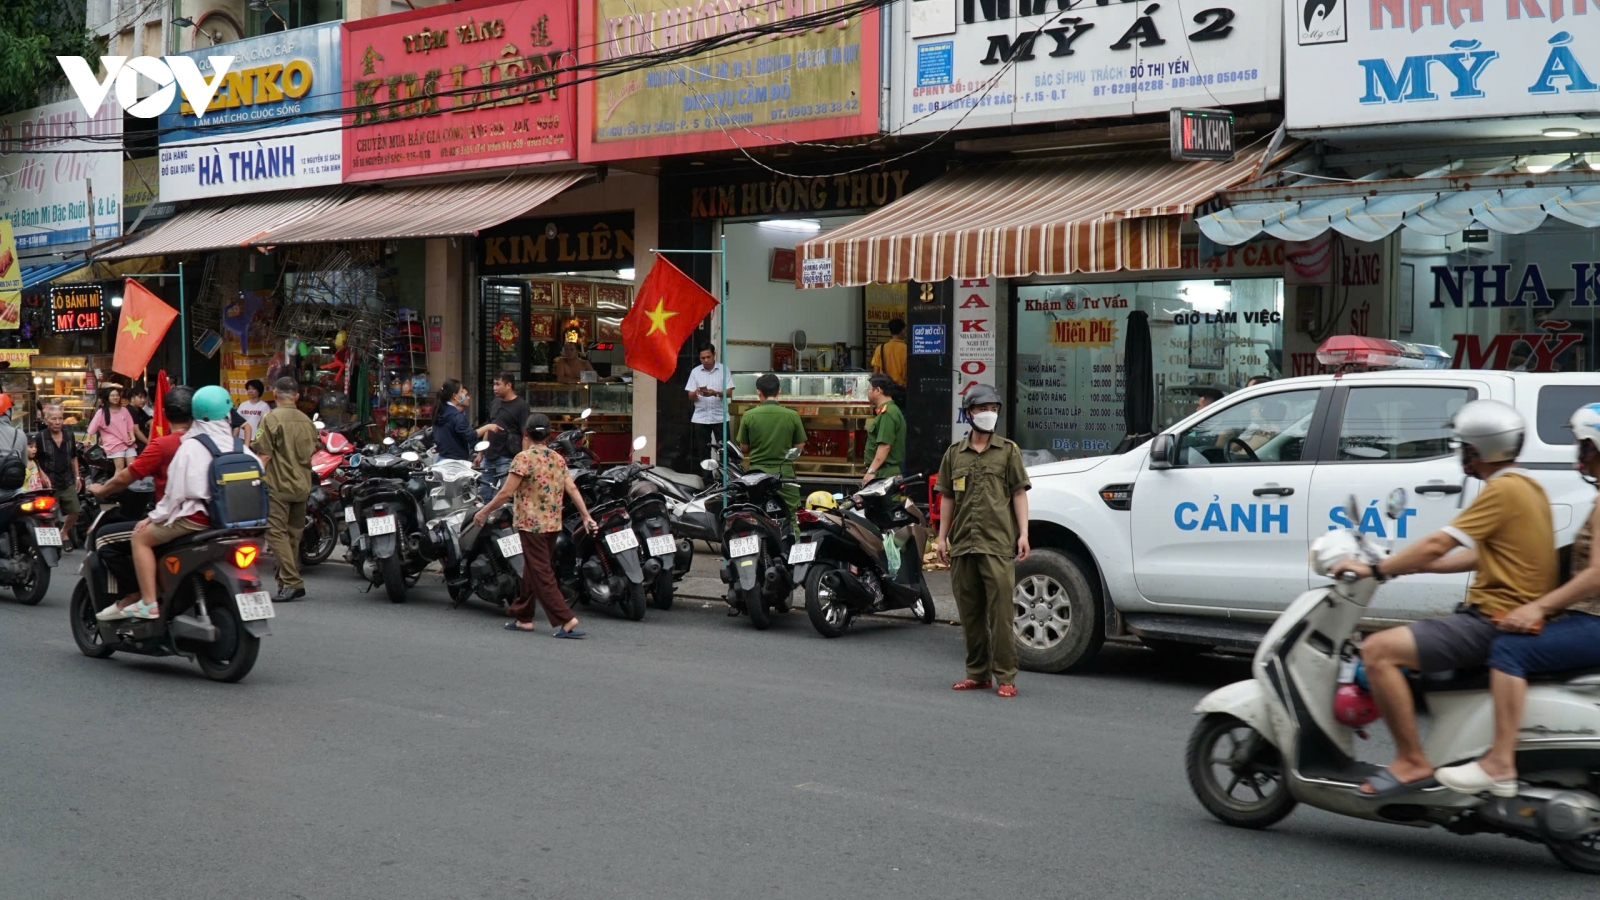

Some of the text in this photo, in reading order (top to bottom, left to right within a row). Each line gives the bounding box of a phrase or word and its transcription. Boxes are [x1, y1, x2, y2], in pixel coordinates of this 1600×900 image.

[250, 41, 295, 60] CAO CẤP
[402, 17, 505, 55] TIỆM VÀNG
[979, 17, 1095, 66] MỸ
[1110, 3, 1166, 50] Á
[1188, 8, 1236, 42] 2
[1035, 71, 1053, 87] BÁC
[1067, 70, 1086, 86] PHỤ
[1129, 58, 1145, 78] ĐỖ
[1148, 63, 1165, 79] THỊ
[1168, 56, 1190, 75] YẾN
[1358, 31, 1600, 105] MỸ Á
[180, 58, 314, 116] ENKO
[353, 69, 442, 126] KIM
[450, 43, 562, 114] LIÊN
[716, 89, 735, 111] VỤ
[737, 80, 767, 105] CẦM
[770, 75, 791, 100] ĐỒ
[213, 101, 301, 125] MÁT CHO CUỘC SỐNG
[788, 104, 813, 118] 0903
[814, 102, 828, 114] 38
[829, 101, 842, 112] 38
[844, 98, 858, 110] 42
[20, 111, 78, 151] BÁNH
[356, 133, 387, 152] CHUYÊN
[389, 134, 406, 149] MUA
[408, 129, 425, 146] BÁN
[426, 129, 441, 144] GIA
[442, 123, 464, 141] CÔNG
[466, 121, 488, 139] VÀNG
[512, 118, 530, 133] 24K
[1183, 117, 1231, 151] NHA KHOA
[161, 149, 188, 163] CỬA HÀNG
[161, 163, 196, 177] ĐỒ GIA DỤNG
[199, 141, 295, 186] HÀ THÀNH
[301, 157, 306, 165] 12
[329, 152, 341, 162] SÁCH
[330, 163, 341, 172] BÌNH
[22, 207, 39, 227] Bánh
[41, 203, 51, 225] Mì
[53, 203, 66, 226] Đặc
[69, 200, 86, 223] Ruột
[98, 197, 104, 216] &
[107, 193, 116, 216] Lẻ
[691, 184, 736, 218] KIM
[741, 173, 826, 214] HƯƠNG
[484, 222, 635, 265] KIM LIÊN
[1243, 244, 1285, 267] CAO
[1342, 247, 1381, 286] RĂNG
[53, 290, 100, 310] LÒ BÁNH MÌ
[920, 282, 934, 303] 8
[1429, 262, 1554, 309] NHA
[1024, 294, 1128, 312] Khám & Tư Vấn
[1174, 309, 1281, 327] GIỜ LÀM VIỆC
[57, 310, 98, 329] MỸ CHI
[1055, 319, 1112, 343] Miễn Phí
[1239, 354, 1261, 366] 20h
[1452, 320, 1583, 372] MỸ
[1053, 438, 1111, 453] Đặc Biệt
[1174, 494, 1417, 539] CẢNH SÁT
